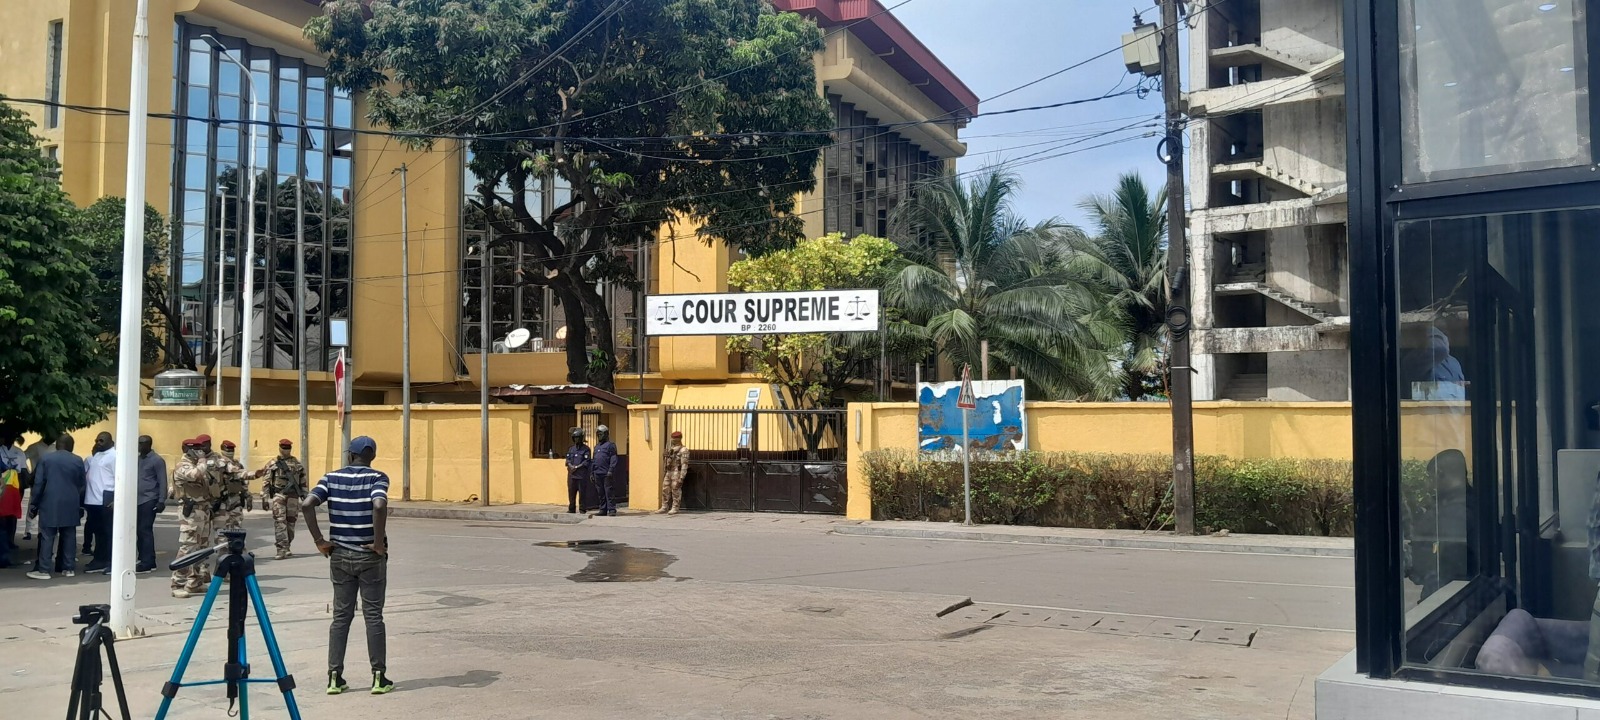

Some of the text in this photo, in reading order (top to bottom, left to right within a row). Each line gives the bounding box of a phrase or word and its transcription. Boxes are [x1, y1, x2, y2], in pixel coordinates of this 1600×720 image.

[682, 296, 840, 324] COUR SUPREME
[758, 323, 777, 331] 2260
